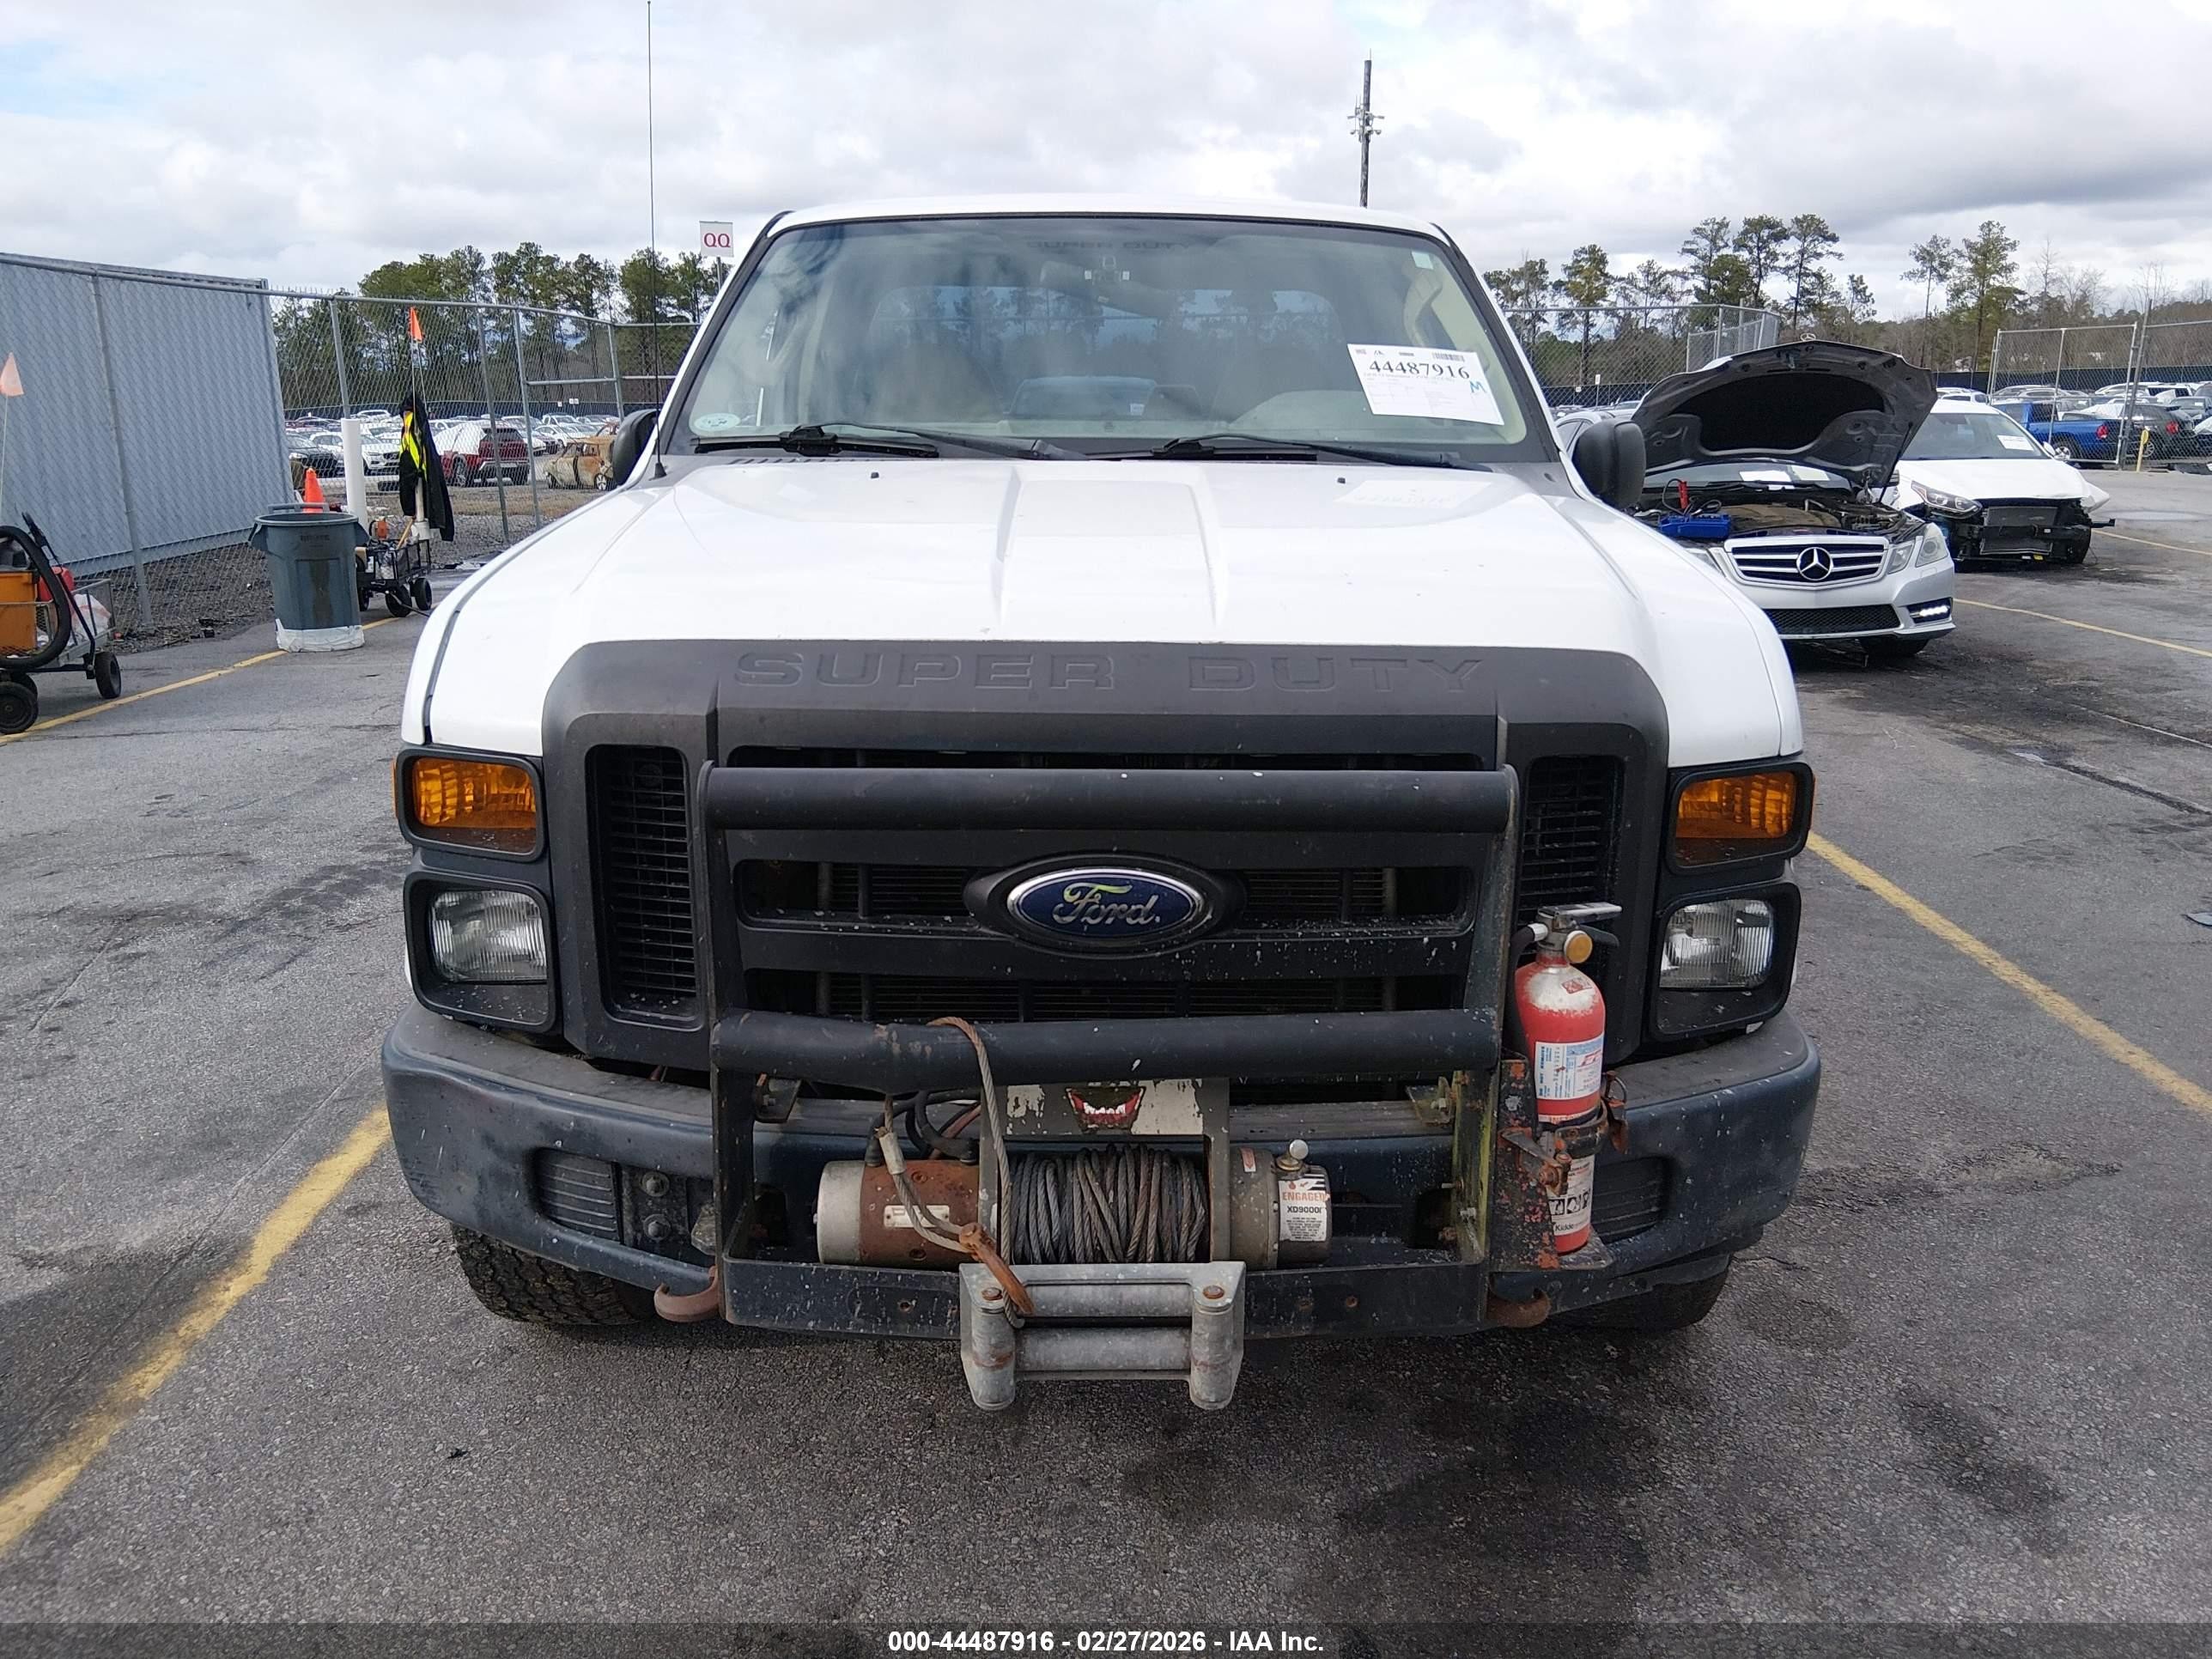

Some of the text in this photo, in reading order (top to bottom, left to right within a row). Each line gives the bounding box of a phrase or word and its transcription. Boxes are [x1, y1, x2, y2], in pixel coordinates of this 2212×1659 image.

[704, 233, 731, 247] QQ
[1370, 361, 1470, 380] 44487916
[733, 653, 1484, 692] SUPER DUTY
[1053, 882, 1159, 925] Ford
